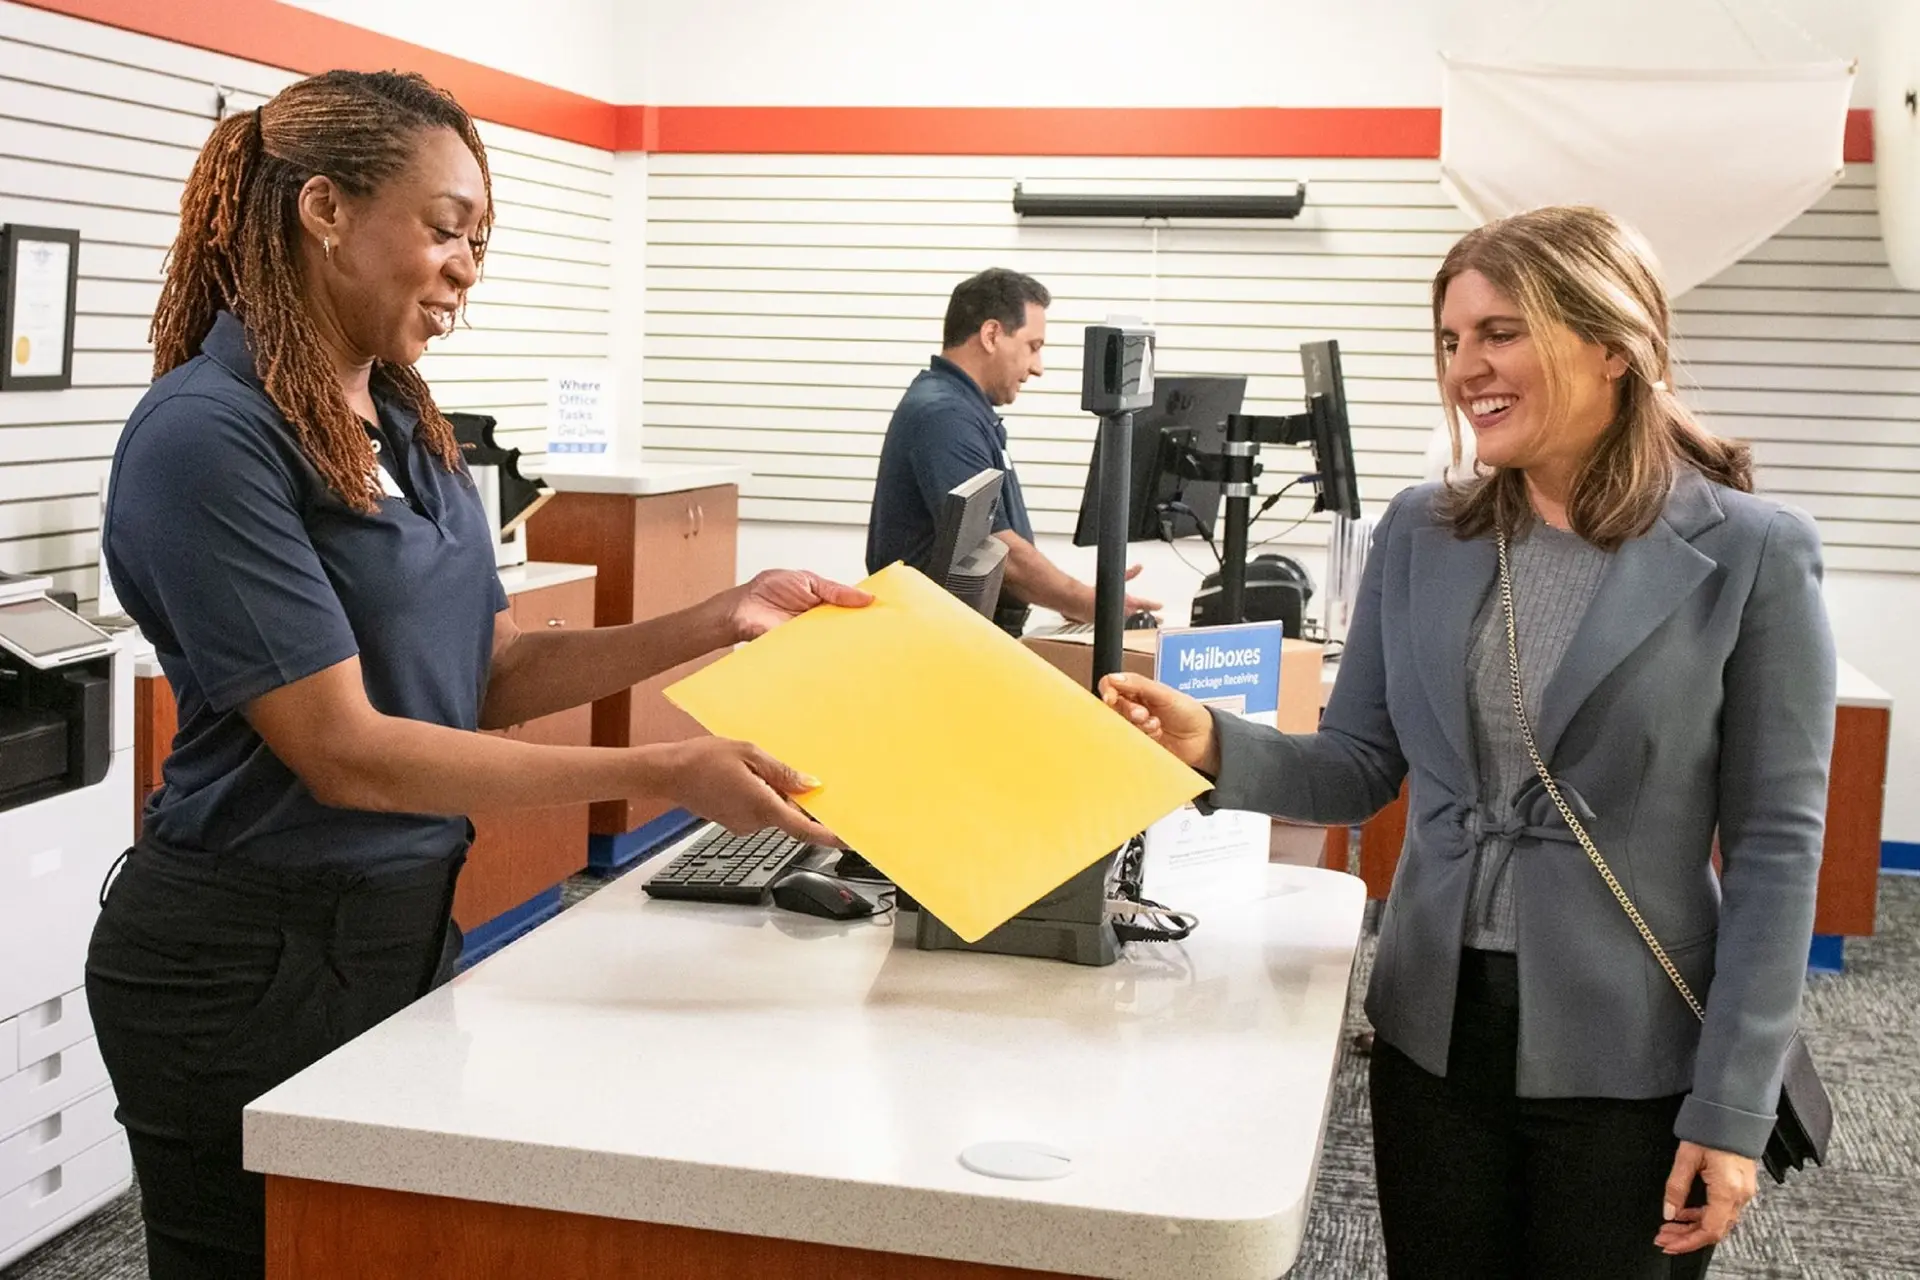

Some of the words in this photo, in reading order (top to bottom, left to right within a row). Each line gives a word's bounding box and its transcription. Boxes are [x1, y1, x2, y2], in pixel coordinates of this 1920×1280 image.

[559, 379, 601, 391] Where
[559, 394, 598, 406] Office
[559, 408, 593, 420] Tasks
[1179, 645, 1262, 672] Mailboxes
[1178, 678, 1192, 690] and
[1192, 675, 1223, 690] Package
[1223, 671, 1260, 686] Receiving
